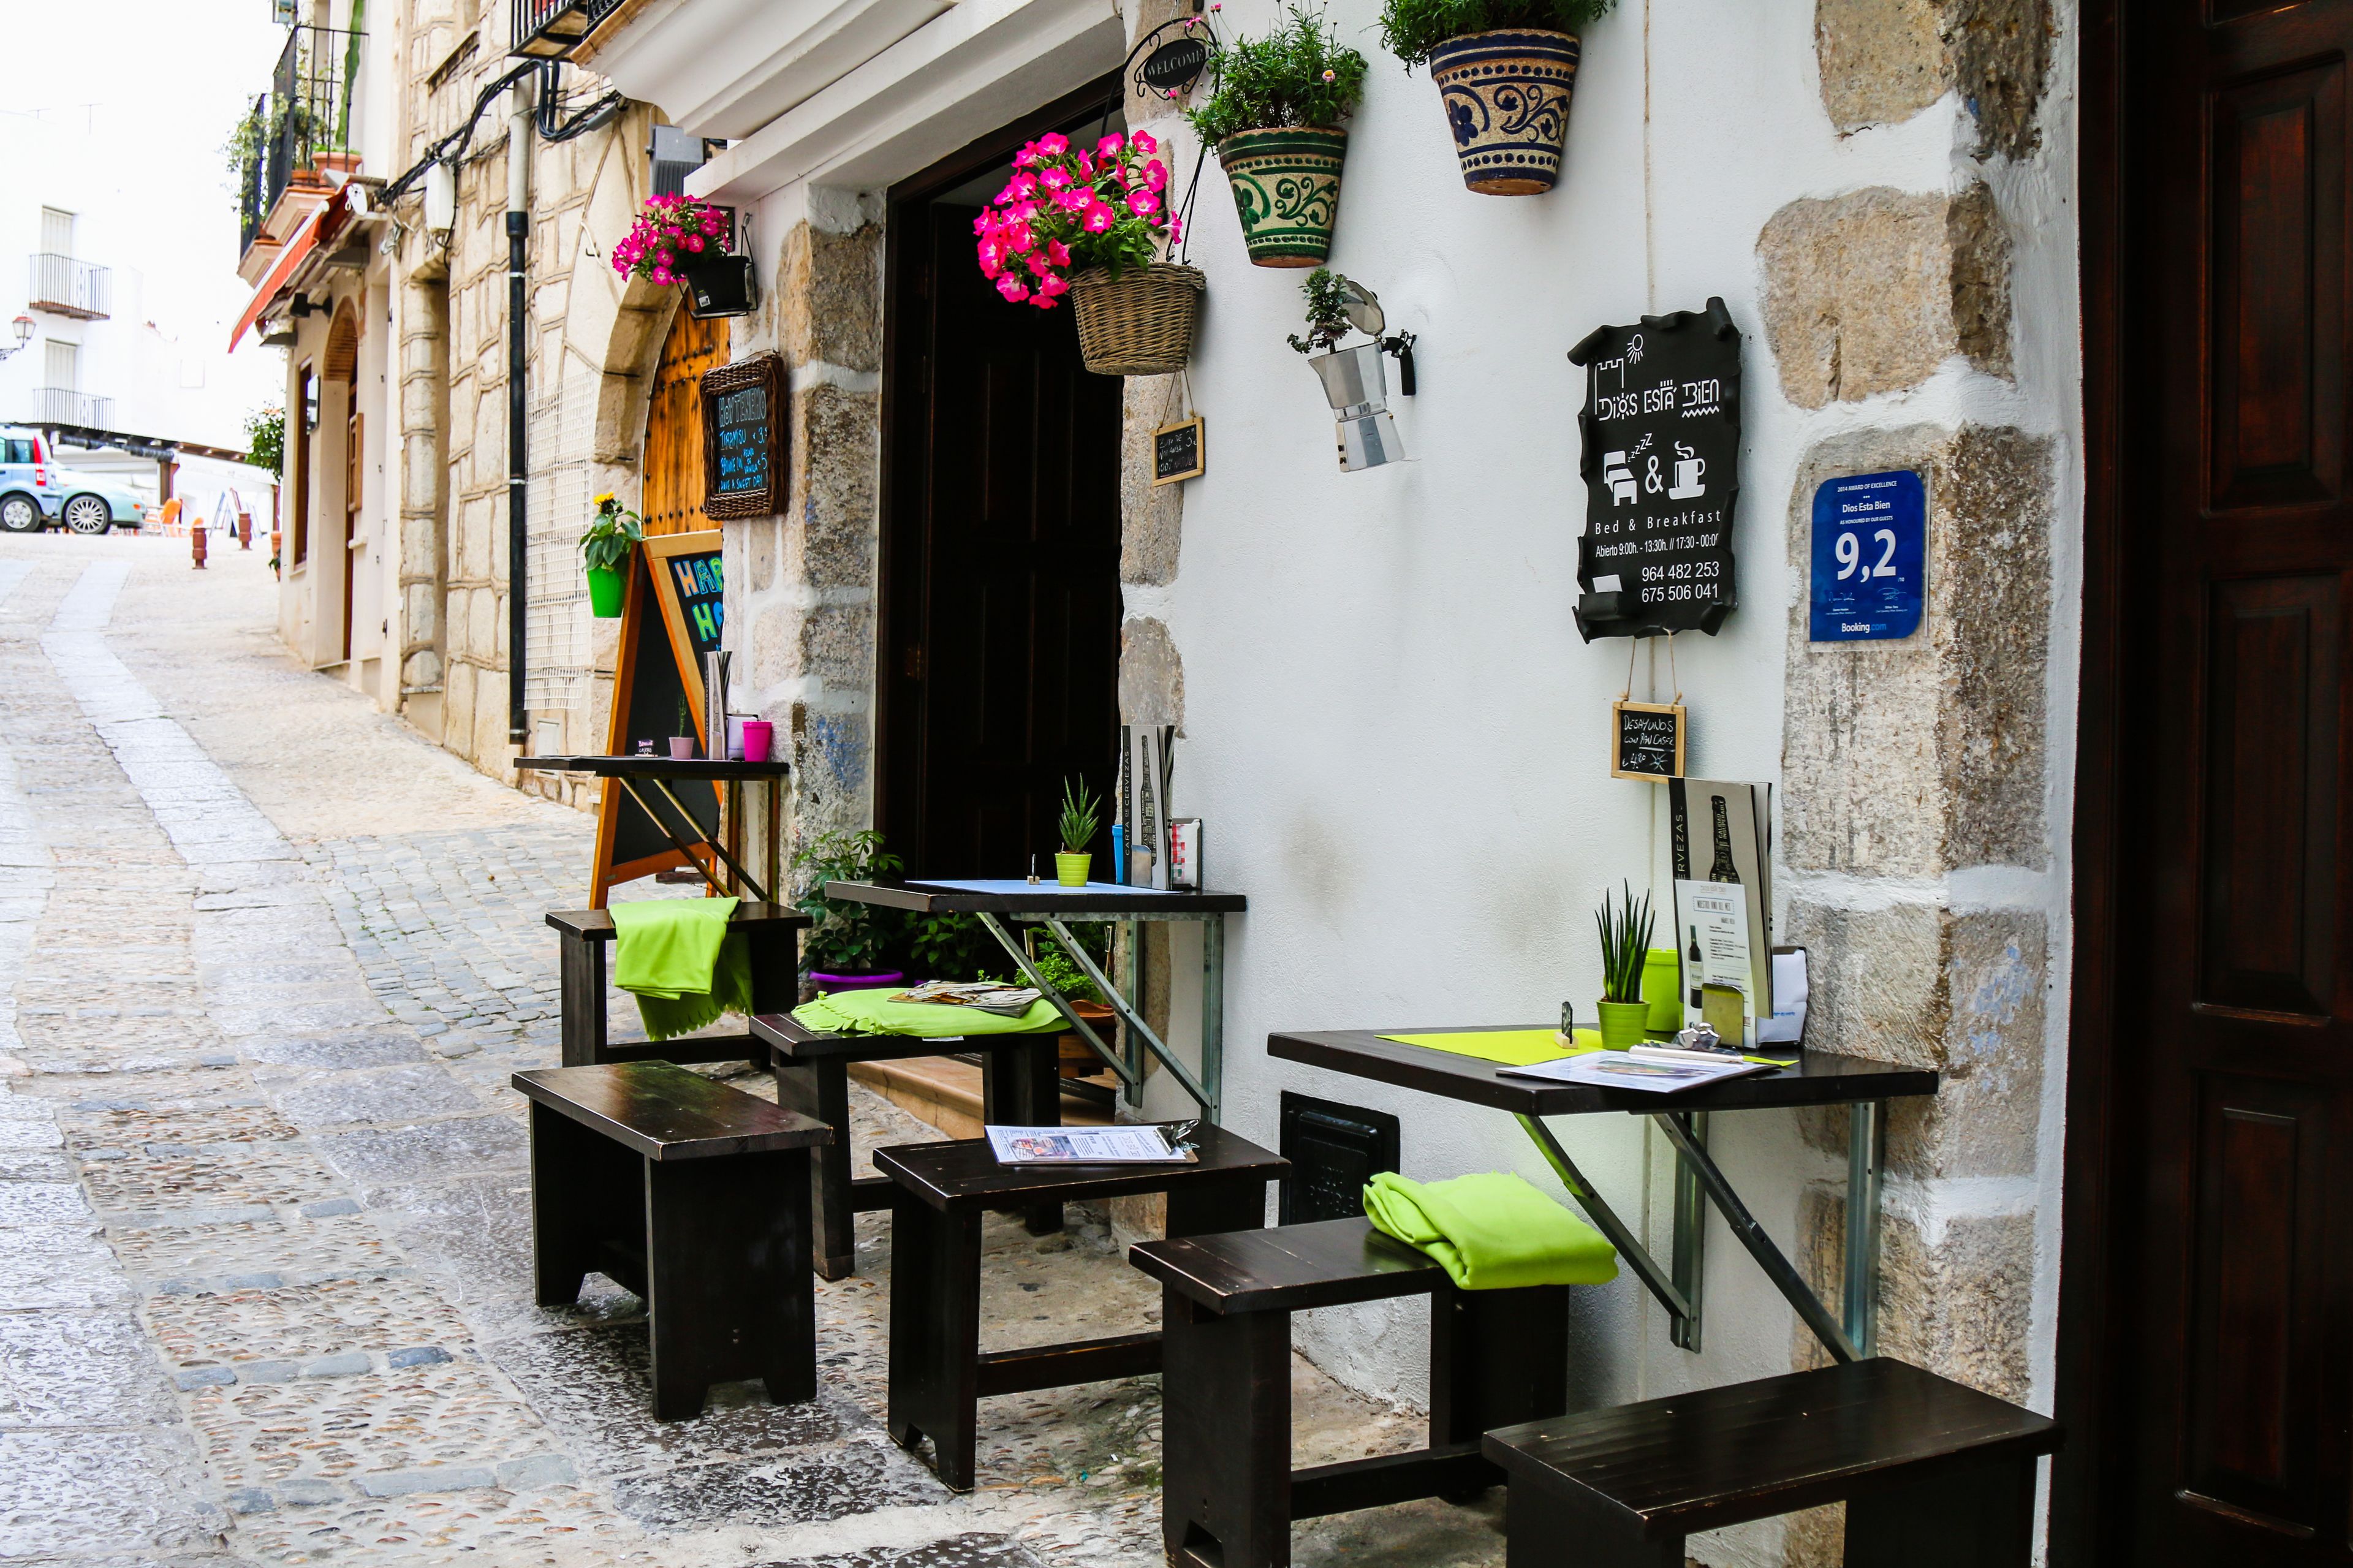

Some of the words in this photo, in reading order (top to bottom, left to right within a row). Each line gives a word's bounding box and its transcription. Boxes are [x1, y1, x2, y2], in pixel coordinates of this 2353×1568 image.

[1148, 48, 1203, 77] WELCOME
[734, 387, 767, 422] TENEMO
[752, 474, 762, 488] DAY
[1871, 480, 1897, 489] EXCELLENCE
[1842, 504, 1858, 513] Dios
[1859, 502, 1873, 512] Esta
[1874, 501, 1890, 510] Bien
[1595, 520, 1619, 535] Bed
[1629, 518, 1636, 531] &
[1647, 510, 1721, 529] Breakfast
[1596, 544, 1618, 558] Abierto
[1619, 542, 1639, 556] 9:00h.
[1644, 539, 1668, 553] 13:30h.
[1677, 536, 1694, 550] 17:30
[1835, 529, 1896, 583] 9,2
[674, 557, 723, 597] HAP
[1642, 566, 1664, 582] 964
[1668, 563, 1692, 579] 482
[1696, 561, 1719, 578] 253
[1642, 587, 1664, 603] 675
[1668, 585, 1691, 601] 506
[1695, 583, 1718, 599] 041
[1841, 622, 1887, 633] Booking.com
[1624, 714, 1673, 732] DESAYUNOS
[1676, 814, 1686, 879] ERVEZAS
